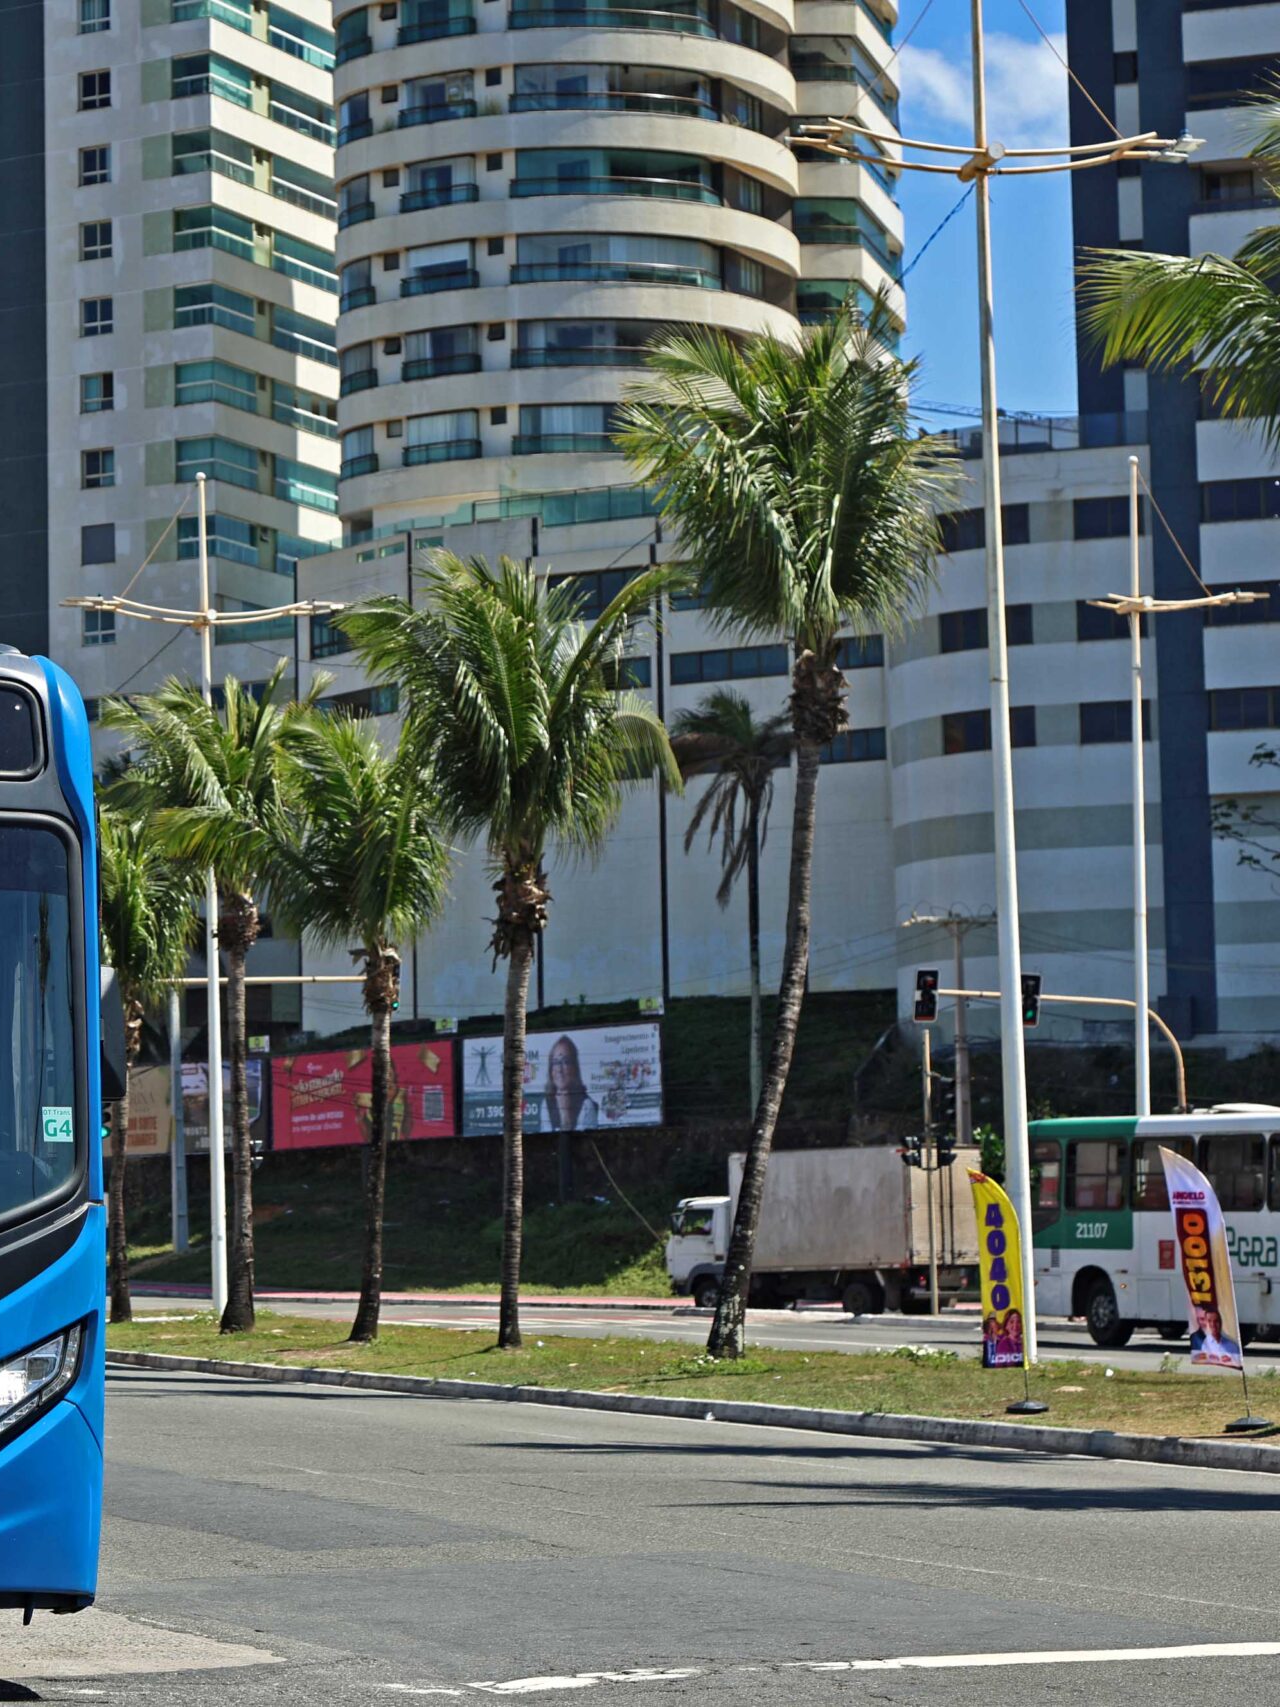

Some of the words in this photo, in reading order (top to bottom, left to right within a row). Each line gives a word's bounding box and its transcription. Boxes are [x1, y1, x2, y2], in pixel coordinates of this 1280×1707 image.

[44, 1119, 72, 1137] G4
[985, 1203, 1011, 1311] 4040
[1075, 1222, 1109, 1239] 21107
[1182, 1212, 1212, 1306] 13100
